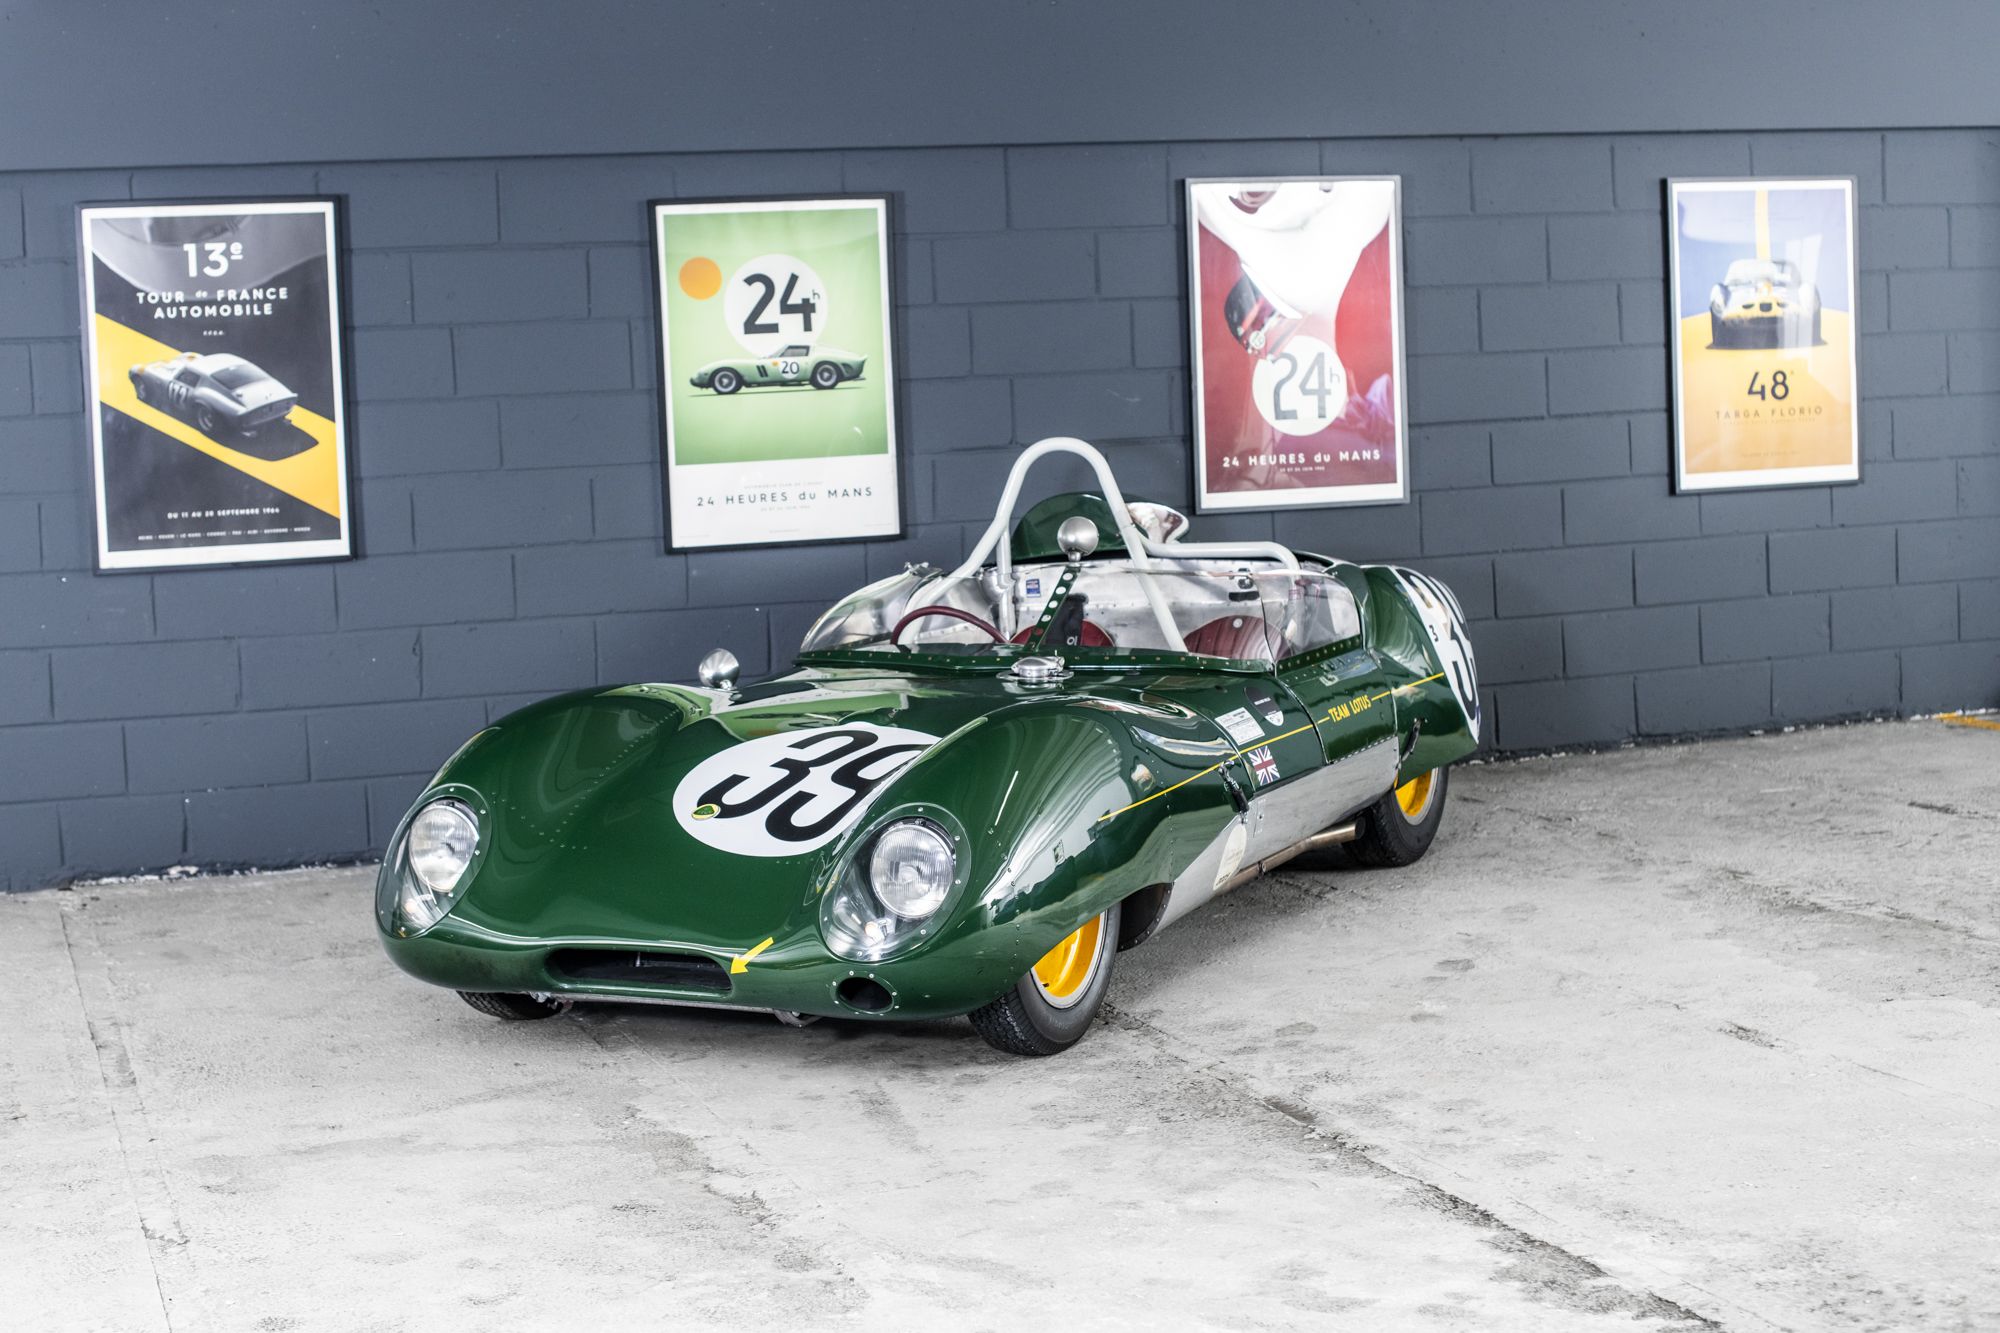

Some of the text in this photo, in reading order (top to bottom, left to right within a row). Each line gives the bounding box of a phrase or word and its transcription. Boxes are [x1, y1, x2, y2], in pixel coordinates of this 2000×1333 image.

[136, 287, 288, 304] TOUR de FRANCE
[154, 303, 273, 319] AUTOMOBILE
[781, 361, 800, 374] 20
[1716, 405, 1823, 419] TARGA FLORIO
[1222, 449, 1381, 467] 24 HEURES du MANS
[697, 487, 872, 507] 24 HEURES du MANS
[1328, 695, 1372, 723] TEAM LOTUS
[697, 729, 937, 842] 39
